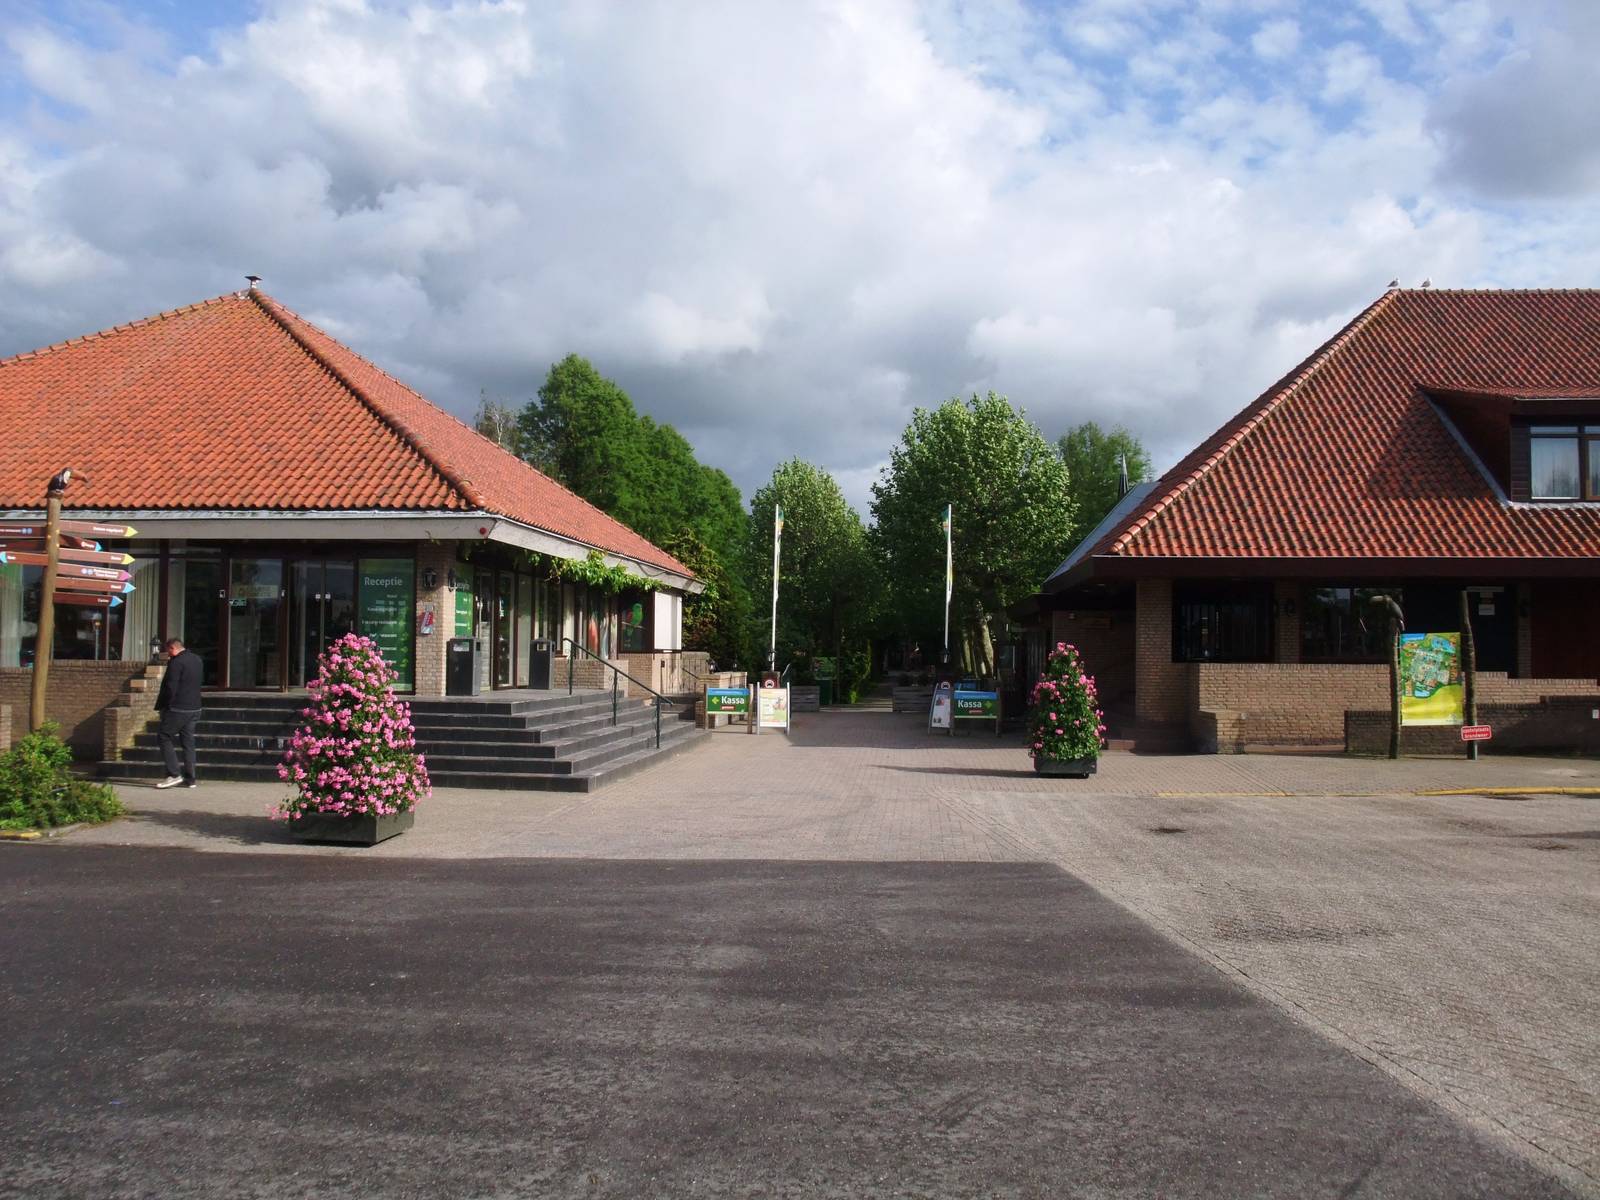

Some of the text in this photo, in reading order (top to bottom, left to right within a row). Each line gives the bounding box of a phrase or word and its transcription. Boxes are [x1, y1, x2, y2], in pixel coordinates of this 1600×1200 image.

[364, 576, 403, 588] Receptie
[721, 695, 745, 704] Kassa
[957, 699, 982, 708] Kassa
